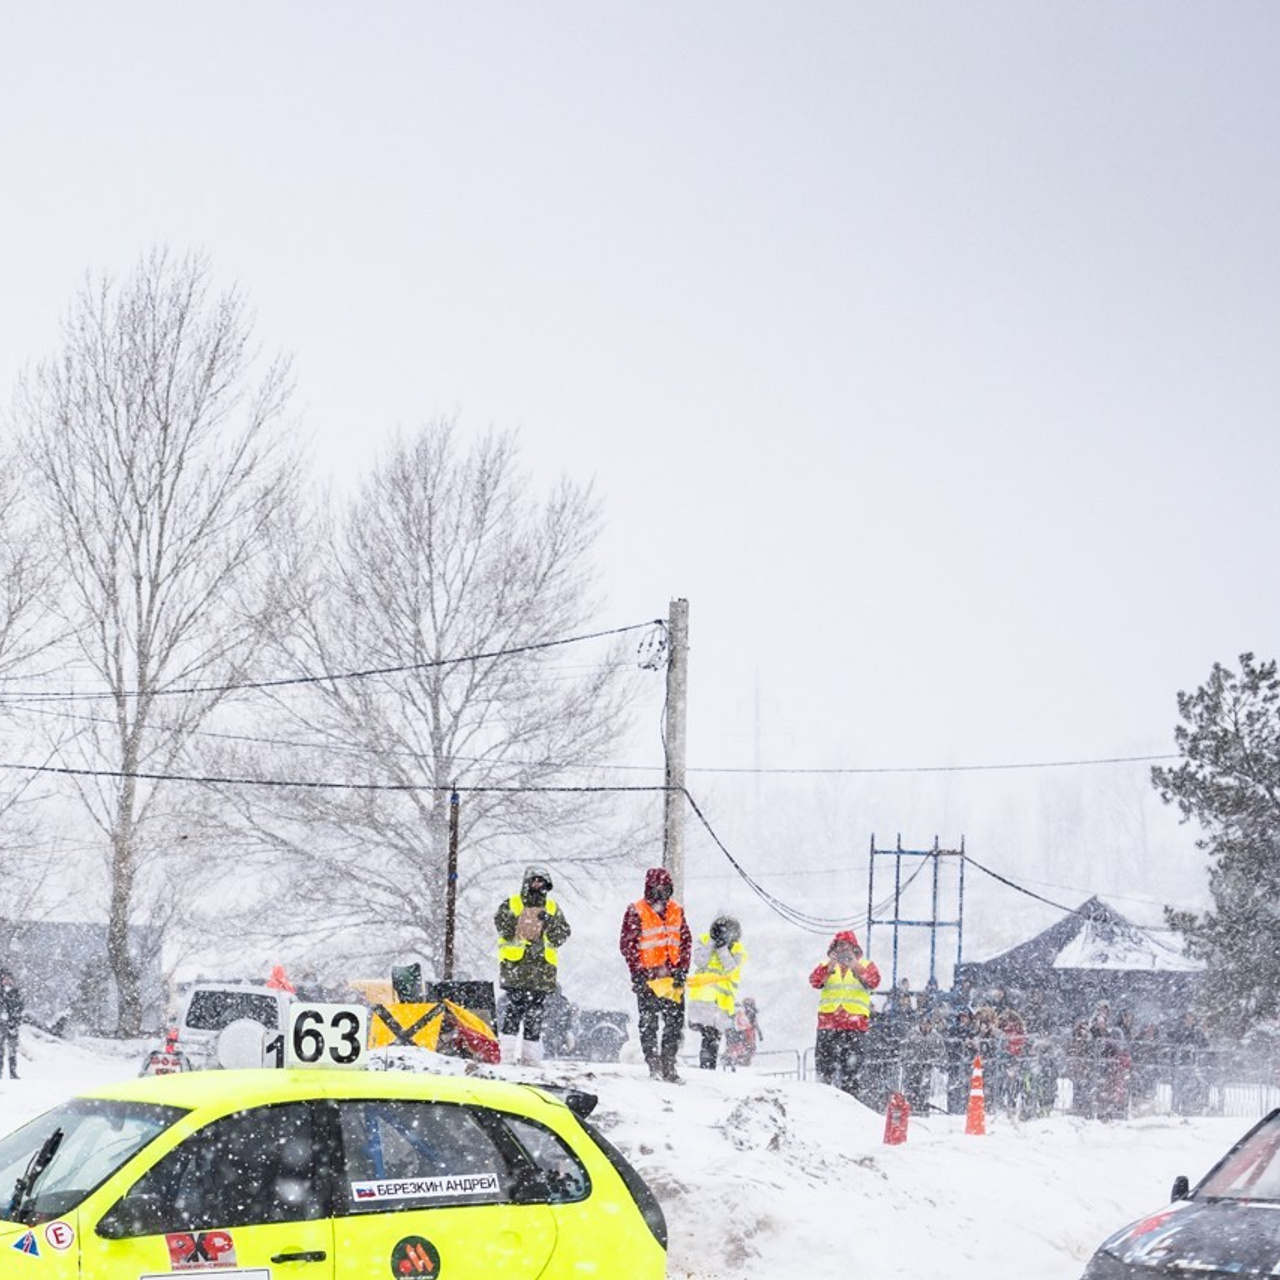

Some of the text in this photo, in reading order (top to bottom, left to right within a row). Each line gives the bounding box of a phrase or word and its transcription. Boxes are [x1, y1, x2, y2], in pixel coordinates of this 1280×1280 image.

[293, 1010, 361, 1064] 63
[376, 1174, 497, 1197] БЕРЕЗКИН АНДРЕЙ
